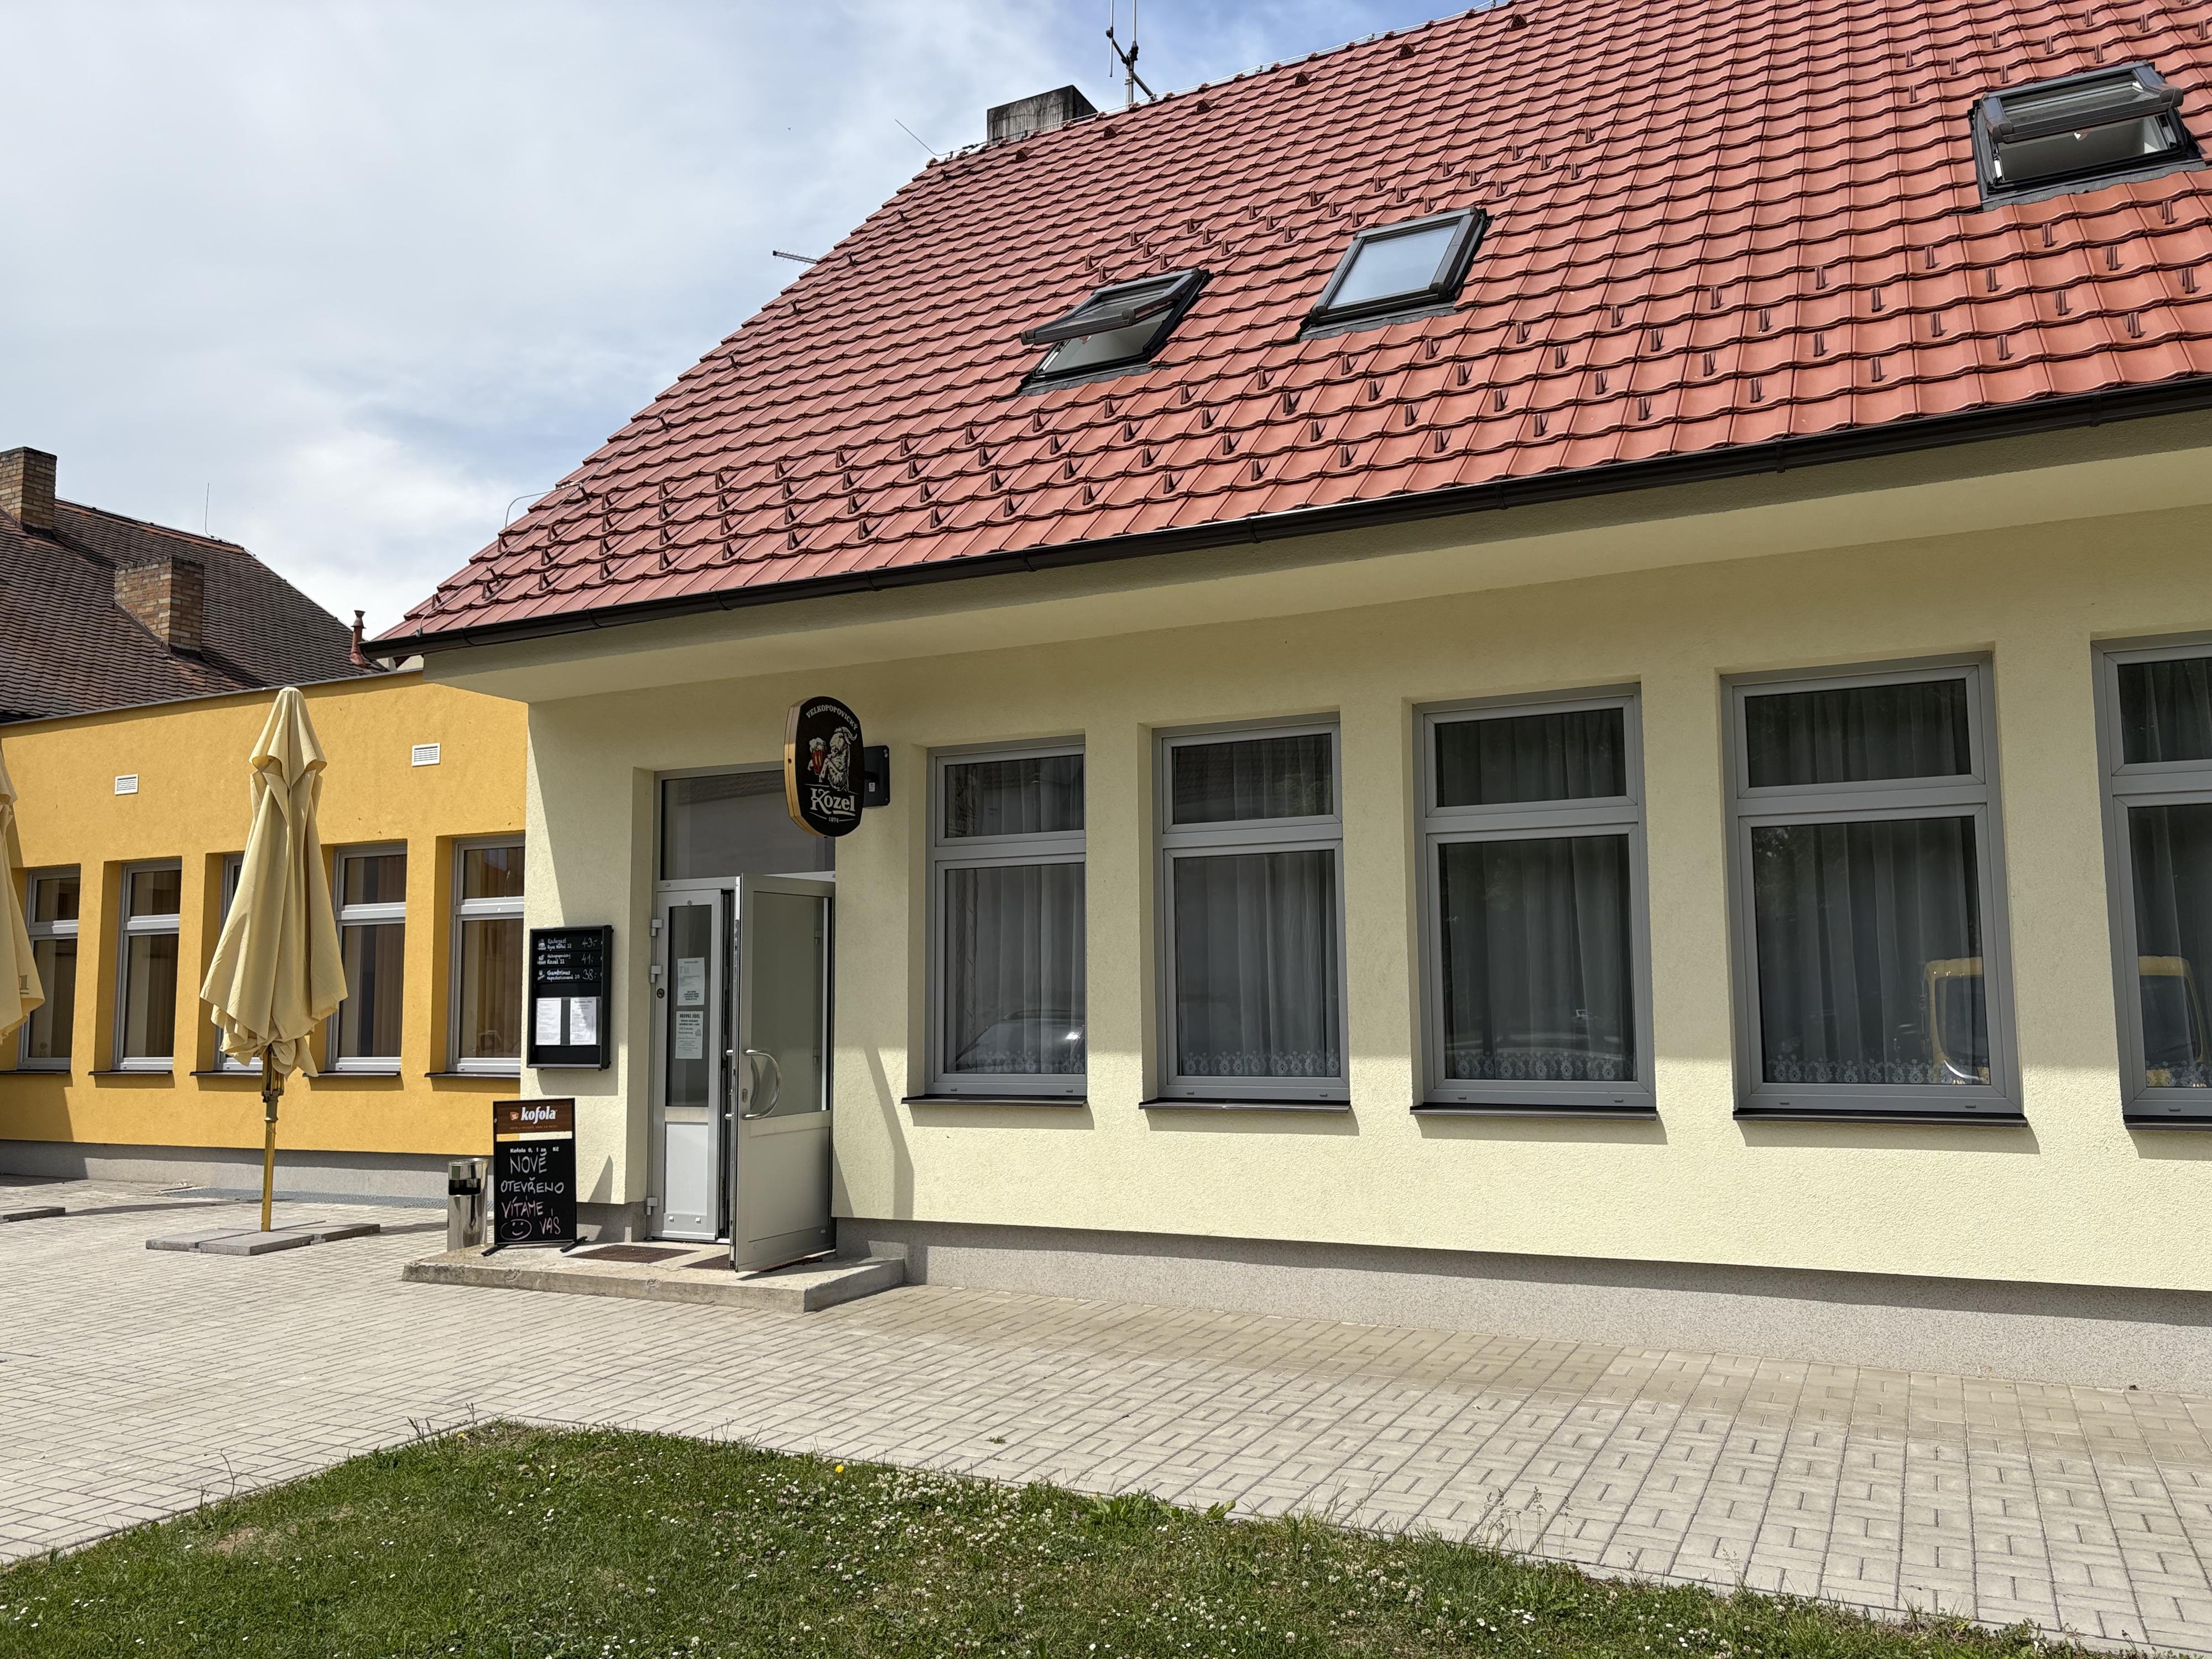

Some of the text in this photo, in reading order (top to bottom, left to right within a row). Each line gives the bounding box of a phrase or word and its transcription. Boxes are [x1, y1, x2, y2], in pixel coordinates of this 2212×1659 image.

[810, 787, 855, 815] Kozel
[520, 1105, 556, 1124] kofola
[500, 1176, 564, 1194] OTEVŘENO
[501, 1195, 544, 1218] VÍTÁME
[539, 1208, 561, 1234] VÁS
